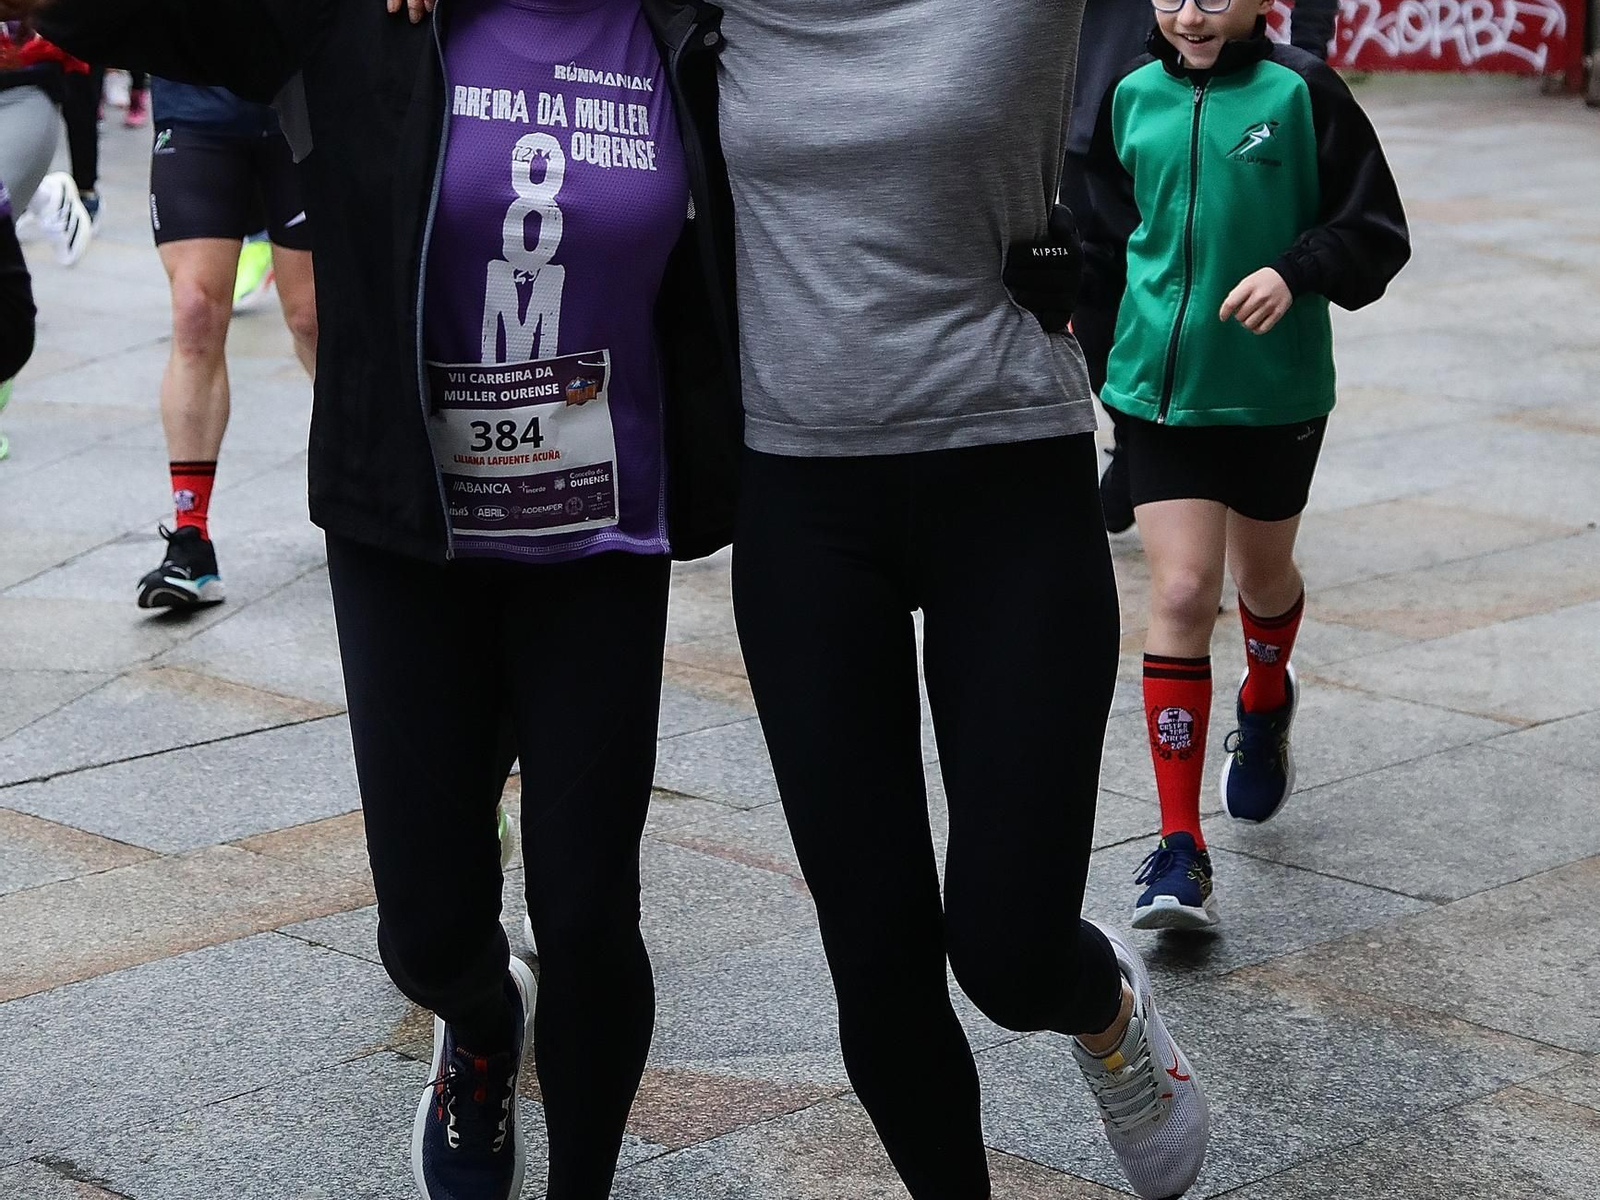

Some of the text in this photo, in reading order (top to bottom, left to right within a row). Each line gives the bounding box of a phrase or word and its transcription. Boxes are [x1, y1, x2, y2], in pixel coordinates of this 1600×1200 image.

[536, 92, 568, 127] DA
[575, 97, 649, 136] MULLER
[571, 131, 657, 171] OURENSE
[1032, 247, 1068, 257] KIPSTA
[448, 366, 554, 384] VII CARREIRA DA
[444, 383, 560, 402] MULLER OURENSE
[469, 416, 545, 453] 384
[488, 454, 530, 466] LAFUENTE
[570, 473, 610, 488] OURENSE
[477, 508, 505, 517] ABRIL
